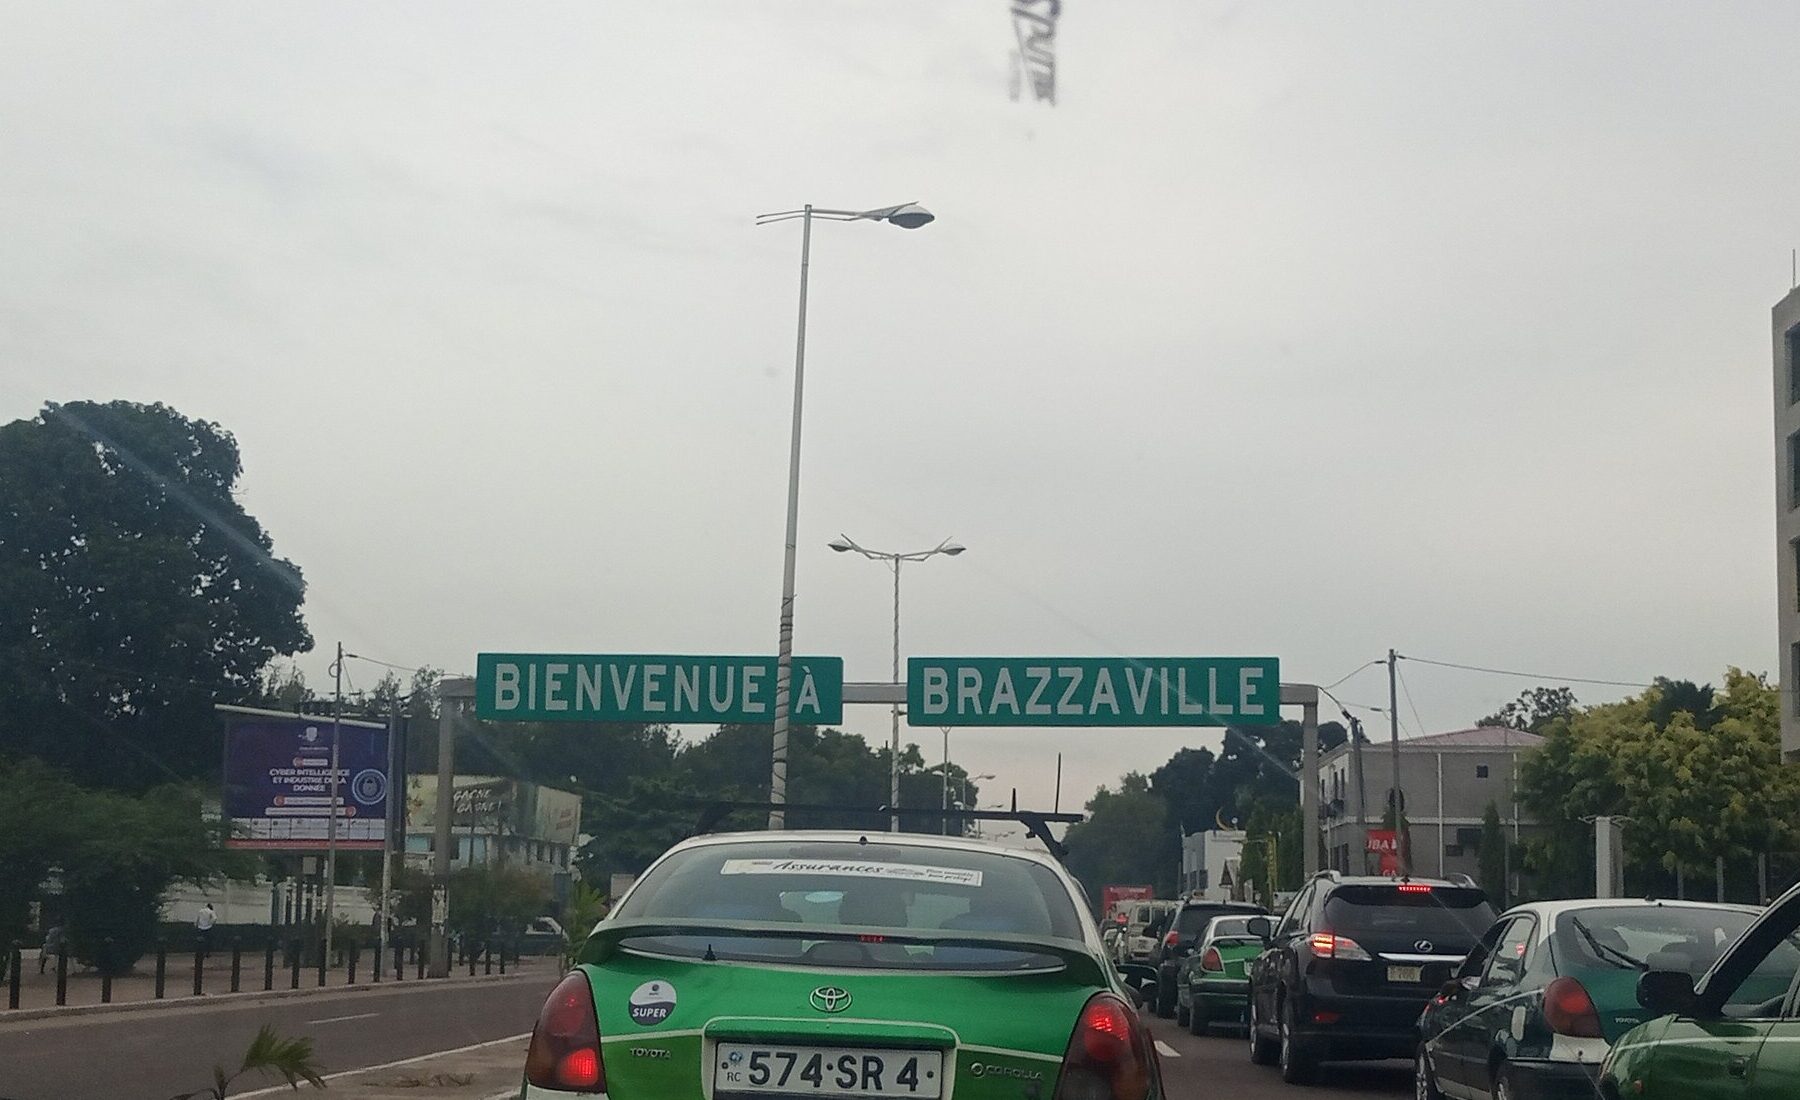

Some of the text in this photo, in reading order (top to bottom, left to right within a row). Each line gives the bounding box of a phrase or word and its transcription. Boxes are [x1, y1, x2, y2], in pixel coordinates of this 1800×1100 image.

[495, 663, 821, 714] BIENVENUE À
[923, 667, 1265, 715] BRAZZAVILLE
[269, 768, 295, 776] CYBER
[773, 860, 884, 873] Assurances
[632, 1007, 667, 1018] SUPER
[630, 1047, 672, 1059] TOYOTA
[726, 1071, 741, 1082] RC
[896, 1057, 919, 1092] 4
